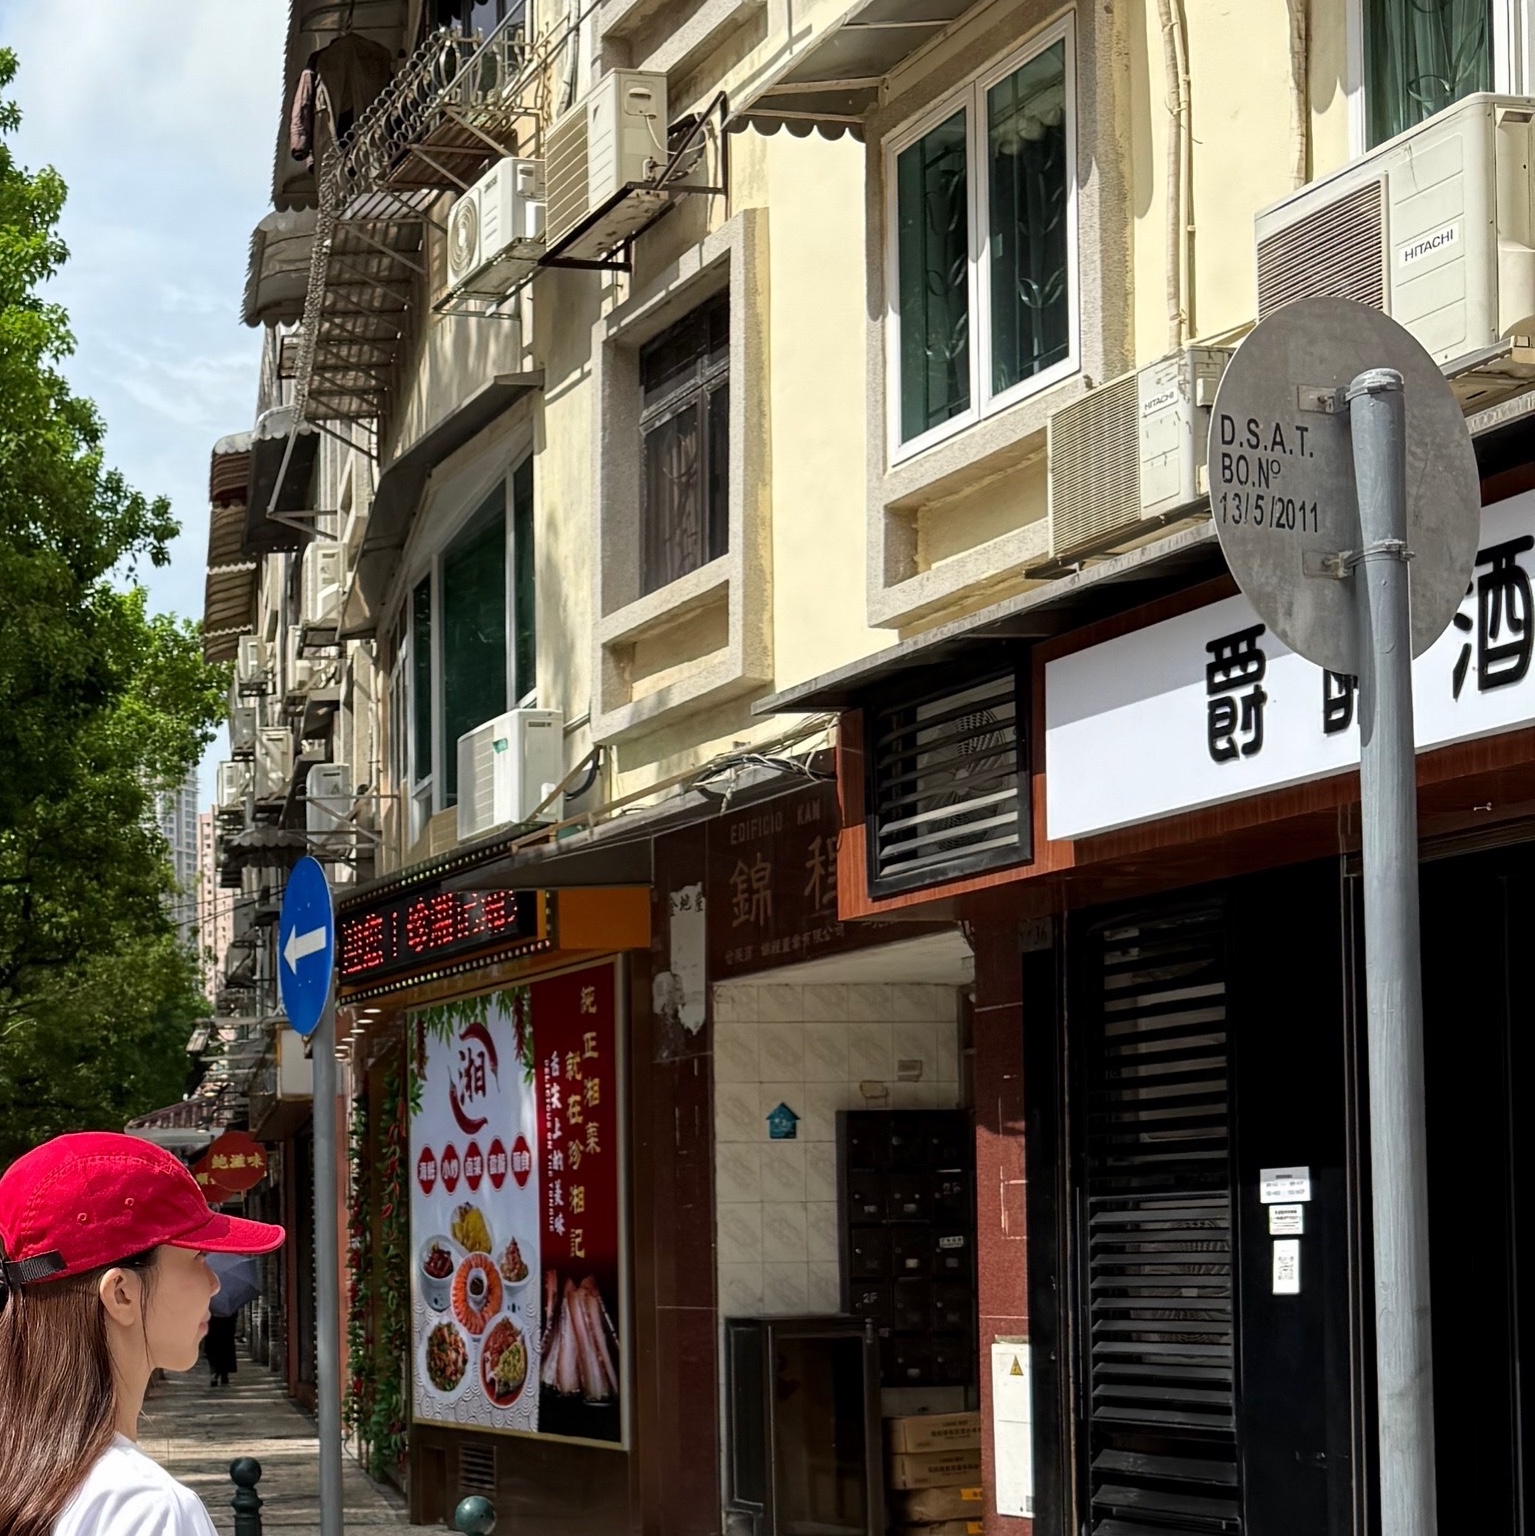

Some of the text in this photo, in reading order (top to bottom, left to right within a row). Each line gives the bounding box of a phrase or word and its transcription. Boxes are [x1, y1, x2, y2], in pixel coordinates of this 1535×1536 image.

[1404, 228, 1454, 262] HITACHI
[1144, 391, 1175, 411] HITACHI
[1220, 414, 1314, 458] D.S.A.T.
[730, 811, 783, 845] EDIFICIO
[459, 1047, 486, 1106] 湘
[580, 985, 602, 1156] 純正湘菜
[565, 1050, 586, 1258] 就在珍湘記
